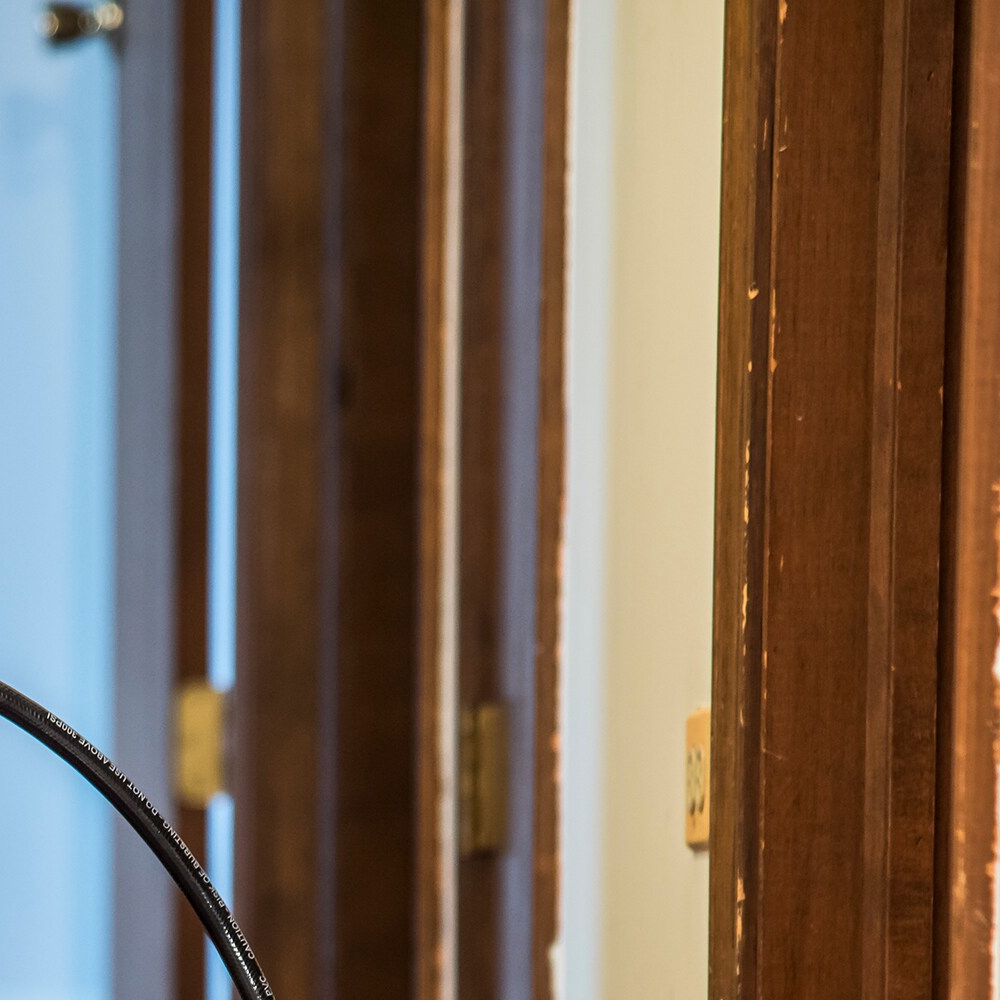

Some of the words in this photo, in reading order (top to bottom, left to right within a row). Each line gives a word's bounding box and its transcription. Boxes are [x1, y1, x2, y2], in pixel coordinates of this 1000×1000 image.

[127, 781, 147, 803] NOT
[145, 801, 160, 816] DO
[227, 914, 256, 960] CAUTION
[259, 975, 273, 997] PVC
